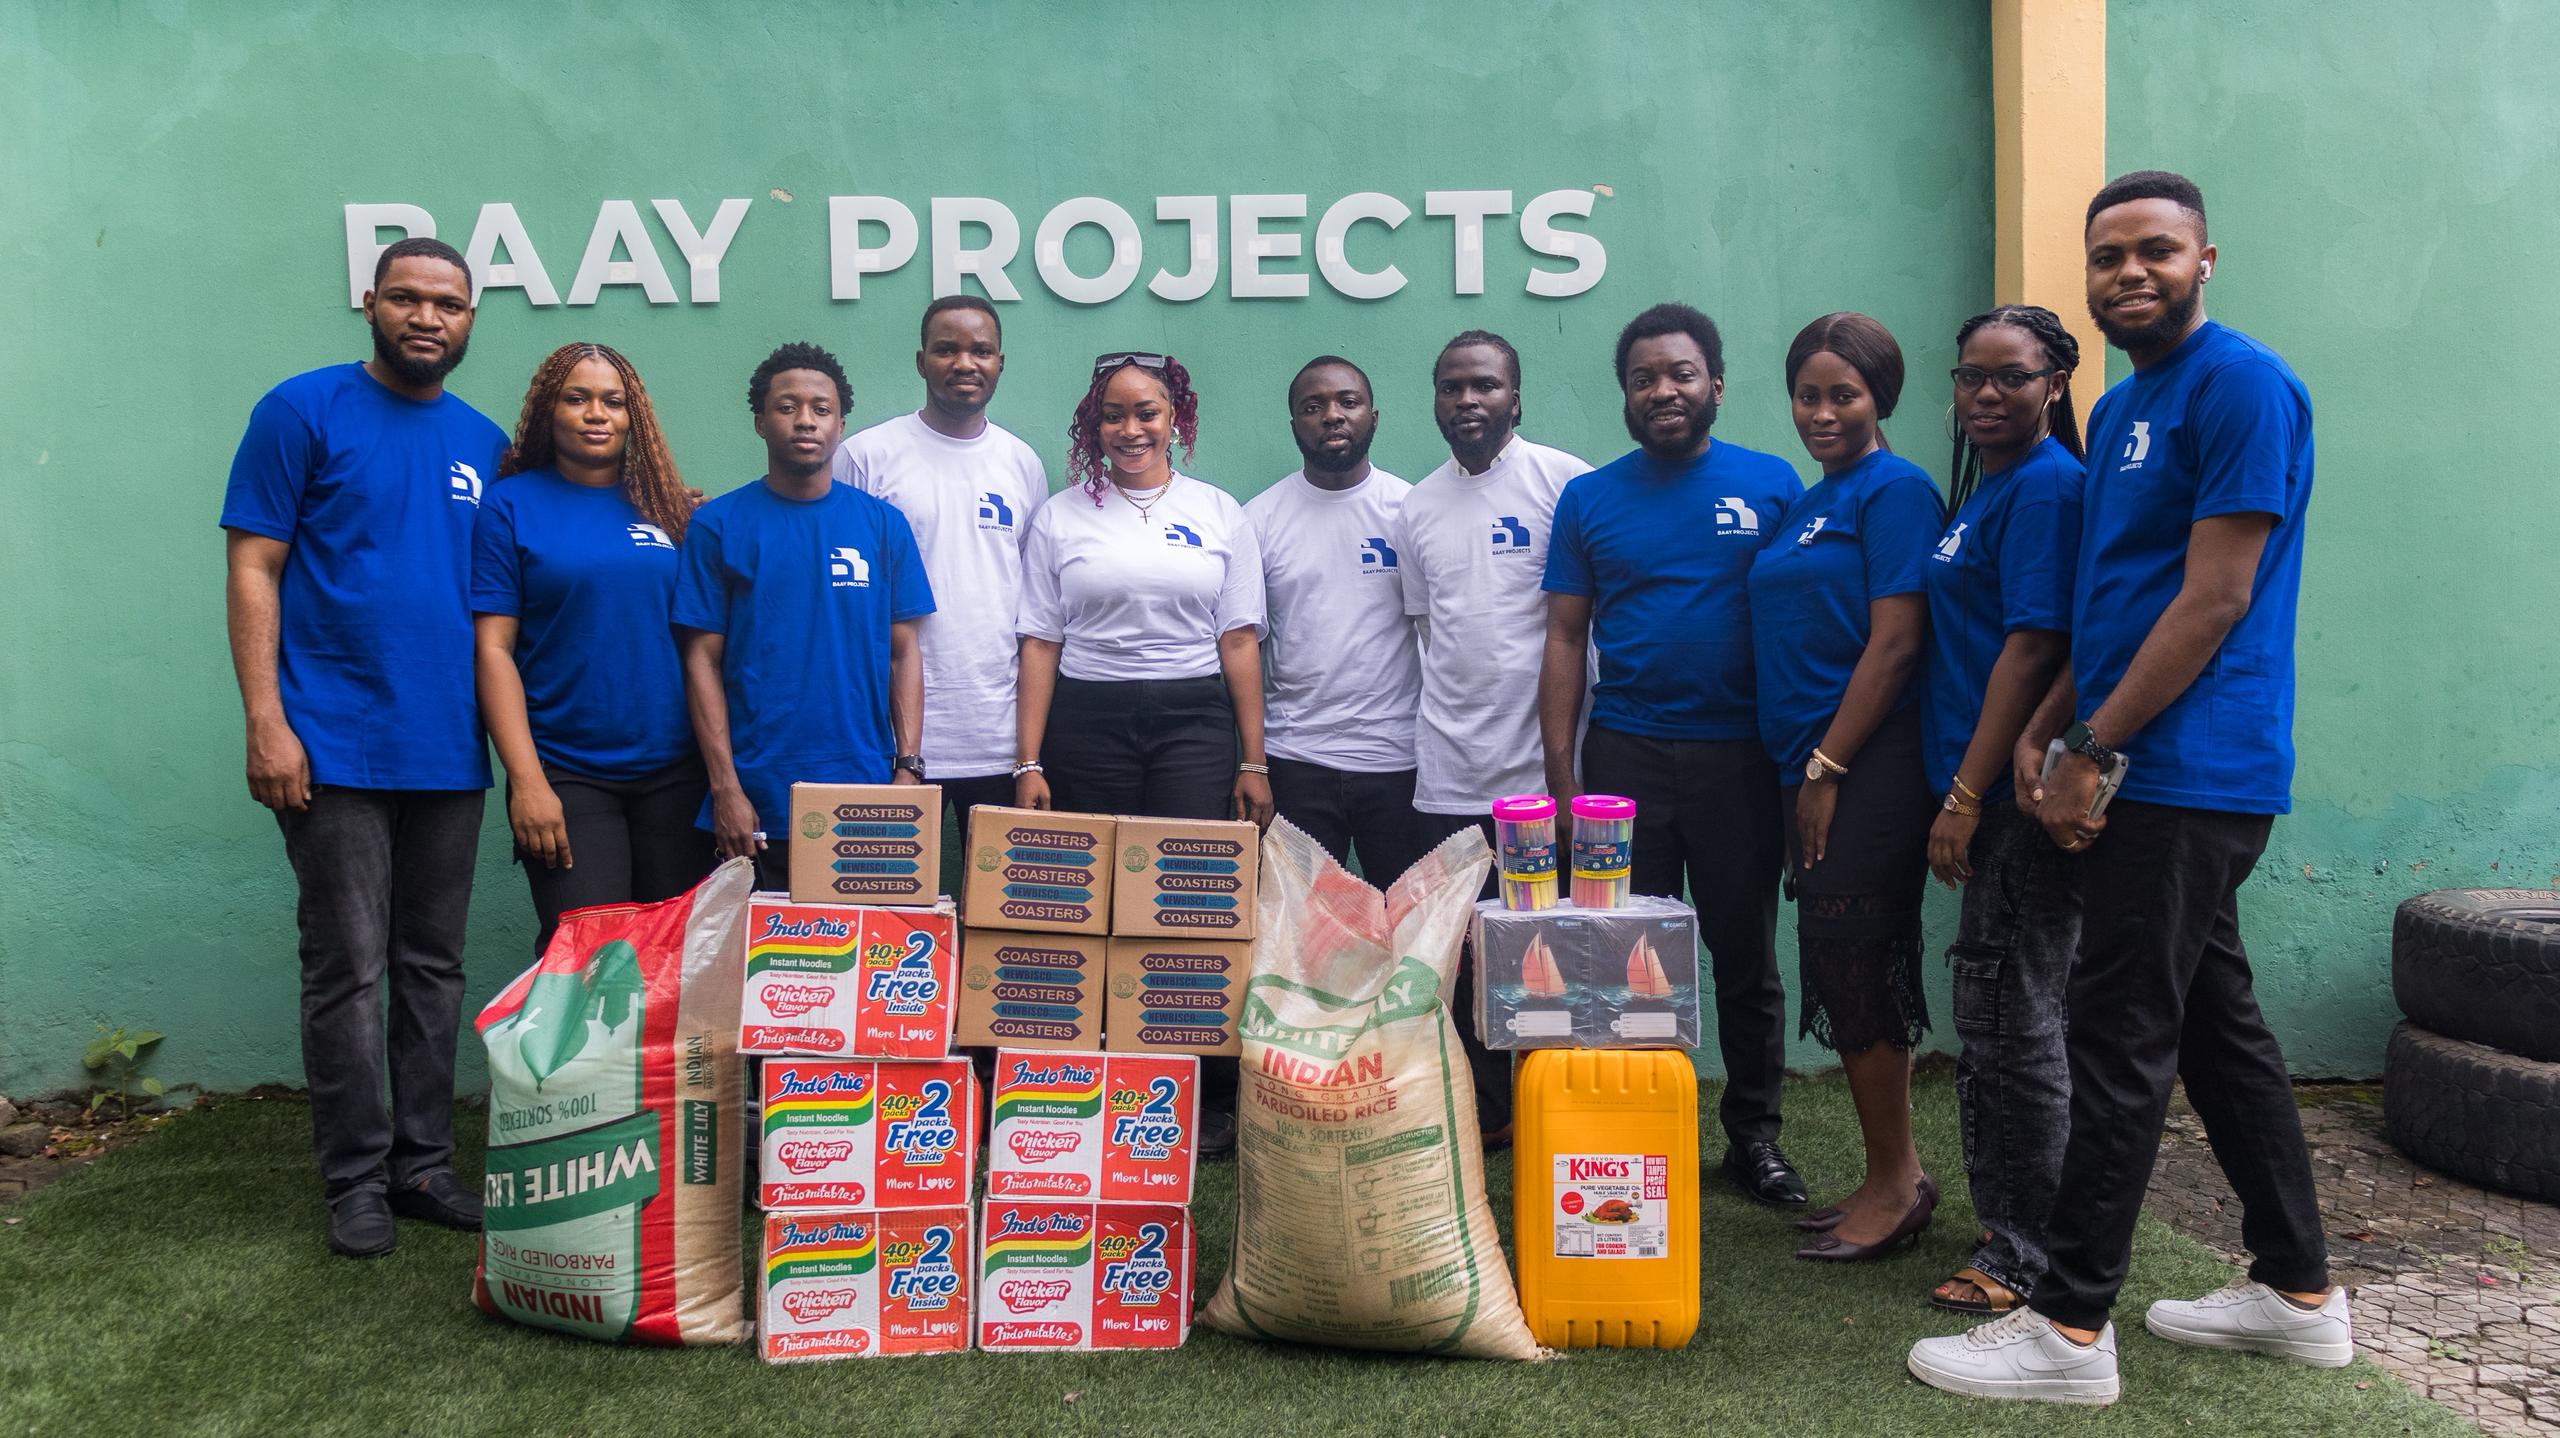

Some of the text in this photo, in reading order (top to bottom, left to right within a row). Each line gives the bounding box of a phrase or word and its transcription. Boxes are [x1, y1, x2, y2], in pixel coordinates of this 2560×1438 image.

[829, 190, 1608, 304] PROJECTS
[840, 808, 914, 818] COASTERS
[1010, 832, 1089, 847] COASTERS
[840, 845, 915, 854] COASTERS
[1163, 842, 1235, 853] COASTERS
[1008, 868, 1086, 883] COASTERS
[840, 881, 914, 890] COASTERS
[1163, 878, 1234, 888] COASTERS
[1004, 905, 1083, 919] COASTERS
[1161, 914, 1233, 924] COASTERS
[901, 932, 935, 969] 2
[770, 957, 832, 969] Instant Noodles
[1000, 951, 1078, 965] COASTERS
[1145, 958, 1222, 969] COASTERS
[897, 969, 930, 980] packs
[868, 971, 937, 1000] Free
[763, 985, 832, 1003] Chicken
[997, 987, 1075, 1001] COASTERS
[1143, 994, 1221, 1006] COASTERS
[776, 1002, 808, 1011] Flavor
[887, 1001, 925, 1014] Inside
[867, 1027, 895, 1039] More
[994, 1023, 1072, 1037] COASTERS
[1142, 1030, 1220, 1042] COASTERS
[687, 1036, 703, 1086] INDIAN
[1262, 1046, 1383, 1087] INDIAN
[1259, 1077, 1387, 1101] LONG GRAIN
[918, 1081, 951, 1118] 2
[1145, 1078, 1178, 1114] 2
[558, 1092, 597, 1120] 100%
[1017, 1104, 1078, 1115] Instant Noodles
[1256, 1090, 1397, 1122] PARBOILED RICE
[786, 1114, 849, 1123] Instant Noodles
[914, 1119, 948, 1128] packs
[1141, 1115, 1174, 1124] packs
[1114, 1119, 1180, 1144] Free
[1276, 1119, 1305, 1138] 100%
[694, 1102, 709, 1183] WHITE LILY
[887, 1124, 955, 1149] Free
[1011, 1132, 1080, 1149] Chicken
[781, 1143, 851, 1160] Chicken
[906, 1151, 943, 1163] Inside
[1024, 1148, 1056, 1158] Flavor
[1131, 1148, 1168, 1158] Inside
[796, 1158, 828, 1168] Flavor
[1569, 1158, 1629, 1180] KING'S
[524, 1137, 656, 1205] WHITE
[1112, 1172, 1140, 1182] More
[886, 1179, 915, 1190] More
[1646, 1175, 1666, 1185] PROOF
[1646, 1186, 1666, 1198] SEAL
[920, 1228, 953, 1264] 2
[1134, 1224, 1168, 1259] 2
[493, 1238, 615, 1270] PARBOILED RICE
[1007, 1255, 1068, 1263] Instant Noodles
[790, 1263, 852, 1274] Instant Noodles
[917, 1264, 950, 1274] packs
[1131, 1259, 1164, 1269] packs
[890, 1269, 957, 1295] Free
[1103, 1265, 1170, 1290] Free
[1001, 1281, 1070, 1298] Chicken
[502, 1280, 605, 1323] INDIAN
[785, 1291, 855, 1308] Chicken
[910, 1298, 946, 1308] Inside
[1014, 1297, 1046, 1307] Flavor
[1122, 1293, 1158, 1303] Inside
[800, 1307, 832, 1317] Flavor
[890, 1325, 919, 1336] More
[1102, 1319, 1131, 1330] More
